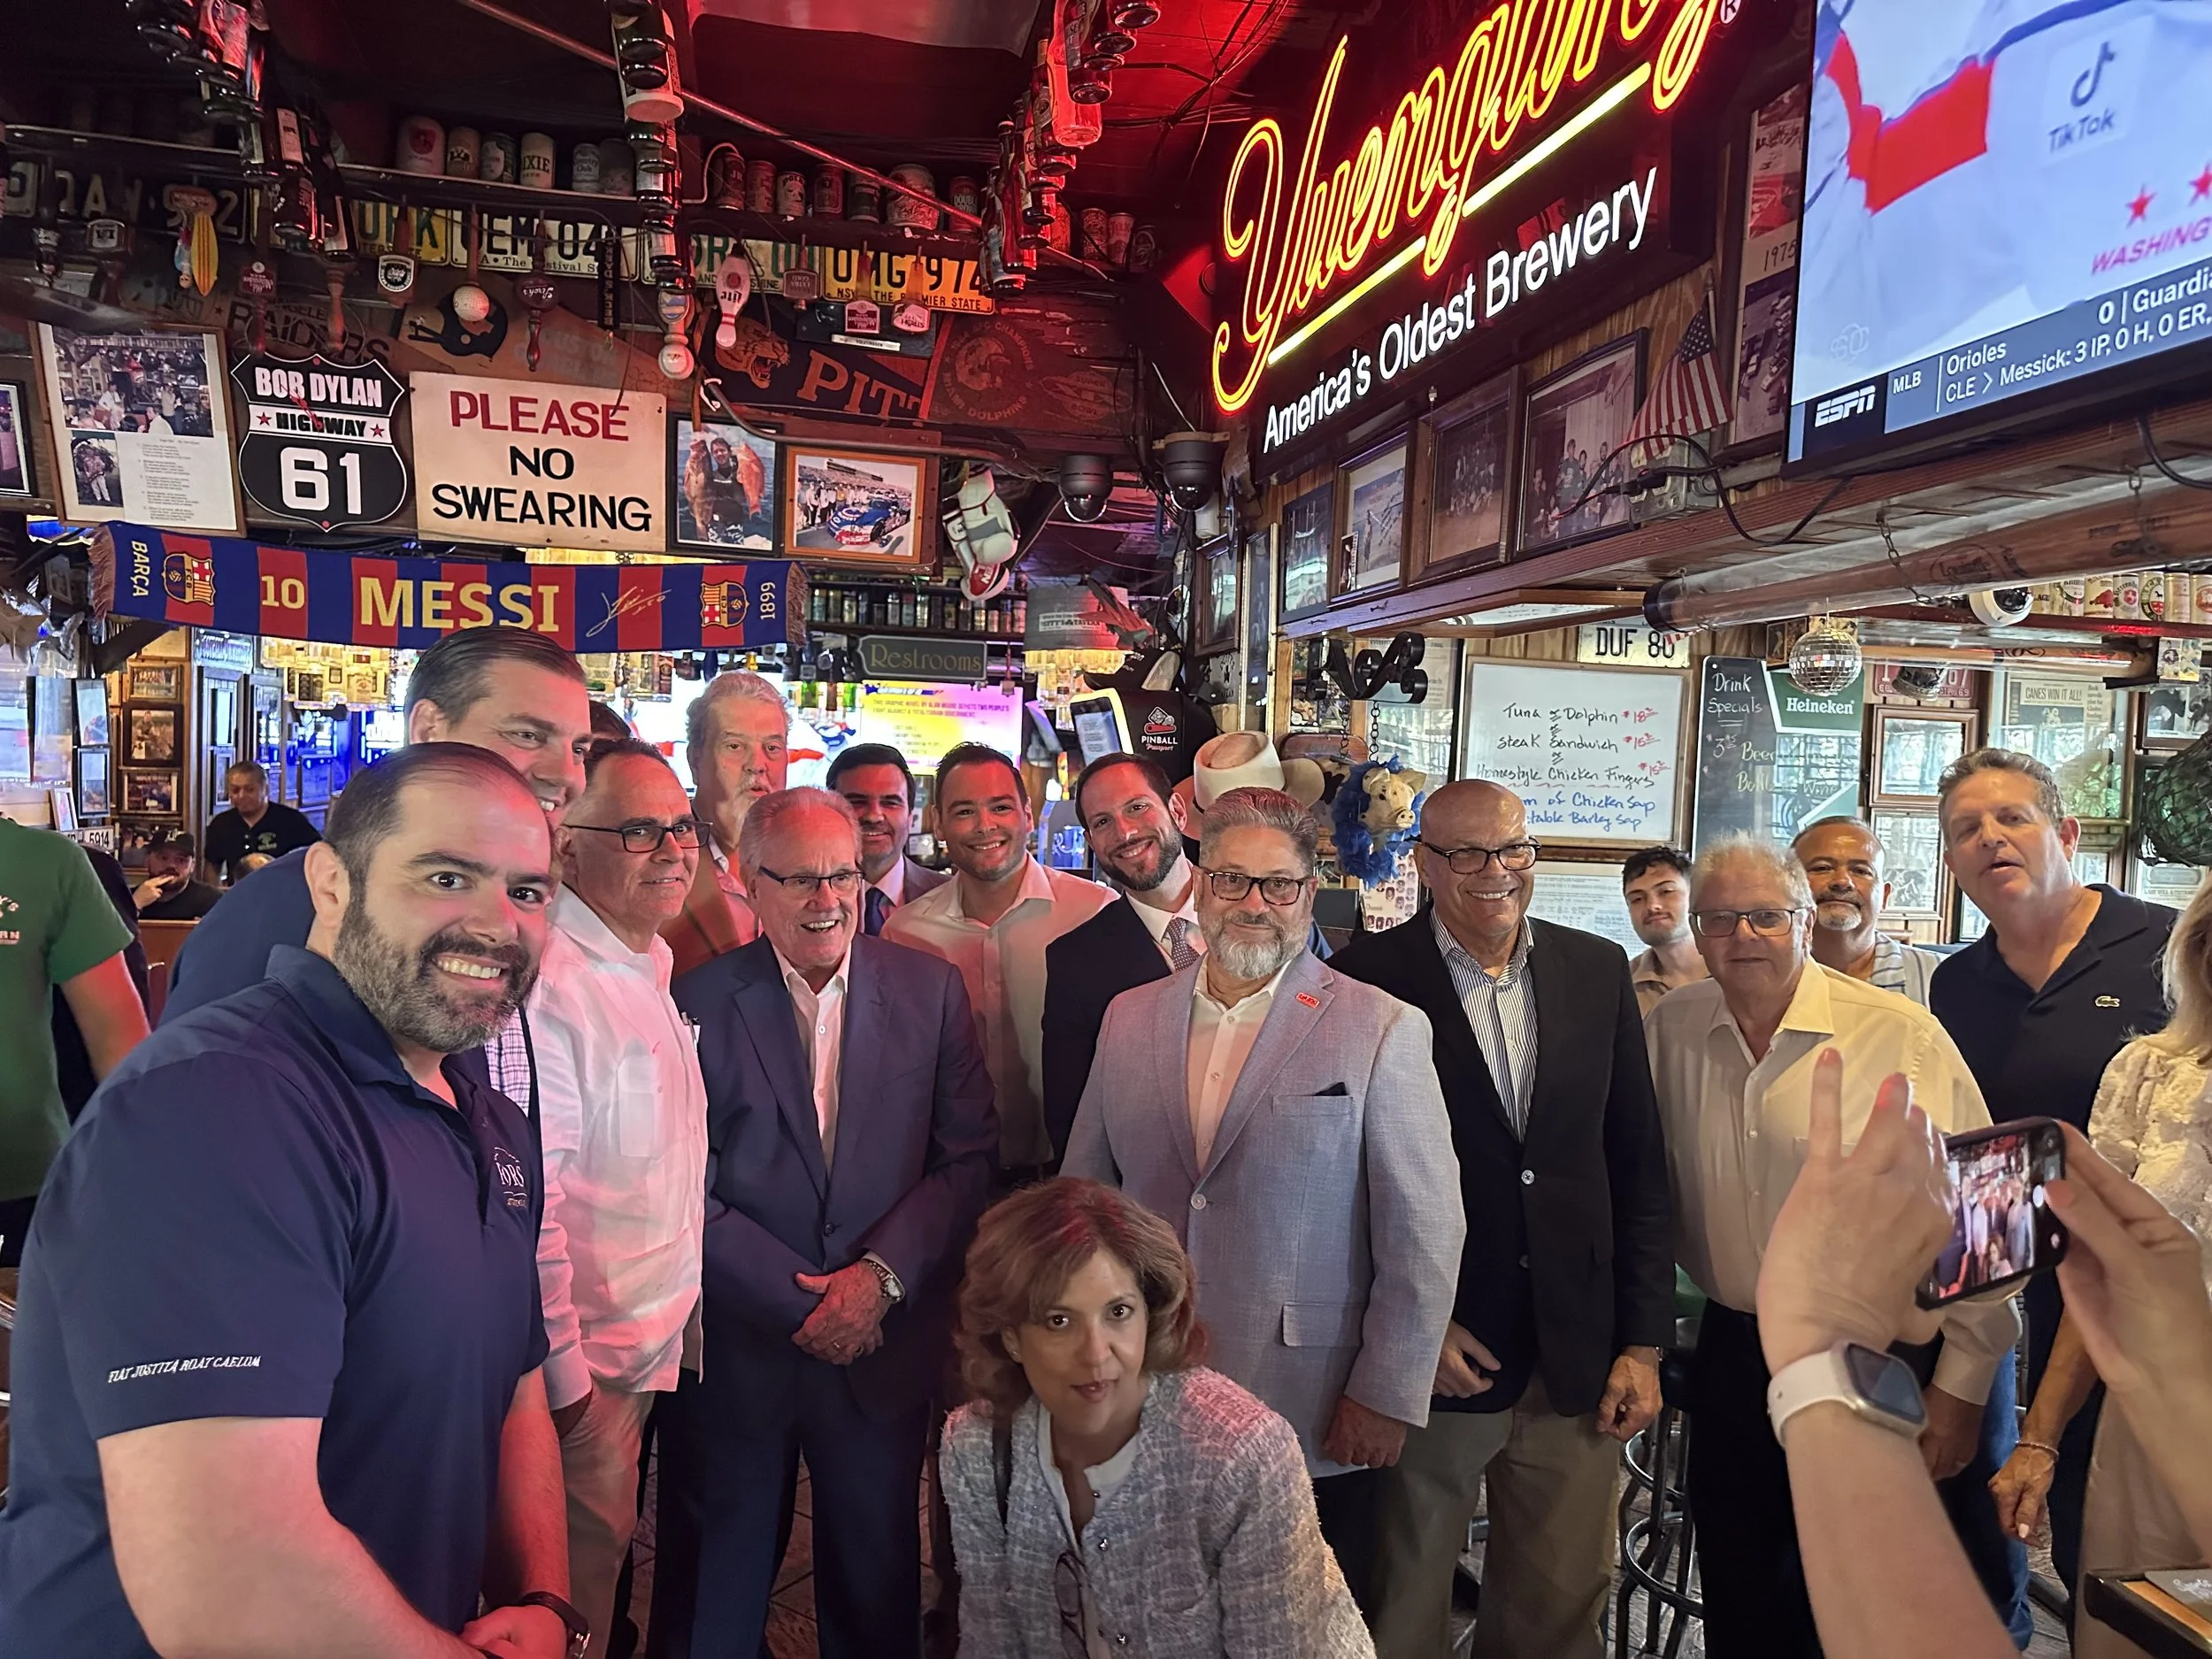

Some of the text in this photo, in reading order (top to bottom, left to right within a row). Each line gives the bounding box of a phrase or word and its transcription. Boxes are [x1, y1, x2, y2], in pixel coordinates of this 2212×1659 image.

[2048, 110, 2116, 153] TikTok
[522, 155, 549, 173] IXIE
[503, 256, 526, 267] The
[720, 290, 742, 304] Lite
[874, 290, 893, 301] THE
[901, 293, 946, 306] PMIER
[952, 298, 981, 311] STATE
[1263, 165, 1658, 455] America's Oldest Brewery
[1946, 302, 2116, 378] Orioles 0
[1946, 380, 1978, 405] CLE
[1999, 352, 2072, 388] Messick:
[2074, 344, 2088, 365] 3
[2090, 332, 2112, 361] IP,
[2114, 327, 2131, 351] 0
[2132, 319, 2155, 347] H,
[2157, 313, 2174, 338] 0
[255, 367, 383, 409] BOB DYLAN
[1076, 375, 1107, 388] SUPER
[1893, 370, 1923, 396] MLB
[450, 389, 630, 442] PLEASE
[966, 396, 1028, 421] DOLPHINS
[1071, 403, 1098, 416] BOWL
[1815, 385, 1876, 428] ESPN
[275, 412, 366, 438] HIGHWAY
[510, 448, 575, 480] NO
[280, 446, 363, 515] 61
[432, 484, 652, 532] SWEARING
[131, 540, 151, 598] BARÇA
[260, 575, 305, 610] 10
[359, 576, 560, 633] MESSI
[760, 581, 776, 620] 1899
[1595, 626, 1638, 657] DUF
[870, 643, 982, 672] Restrooms
[1712, 672, 1752, 693] Drink
[2024, 687, 2083, 702] CANES WIN IT ALL!
[1502, 702, 1542, 719] Tuna
[1563, 707, 1618, 726] Dolphin
[1707, 696, 1763, 718] Specials
[1786, 697, 1854, 715] Heineken
[1141, 735, 1179, 745] PINBALL
[1549, 734, 1619, 753] Sandwich
[1548, 766, 1600, 782] Chicken
[1604, 764, 1655, 790] Fingers
[1548, 790, 1566, 806] of
[1571, 791, 1624, 810] Chicken
[1526, 810, 1565, 824] table
[88, 830, 110, 849] 5914
[107, 1366, 134, 1383] FIAT
[212, 1356, 262, 1368] CAELUM
